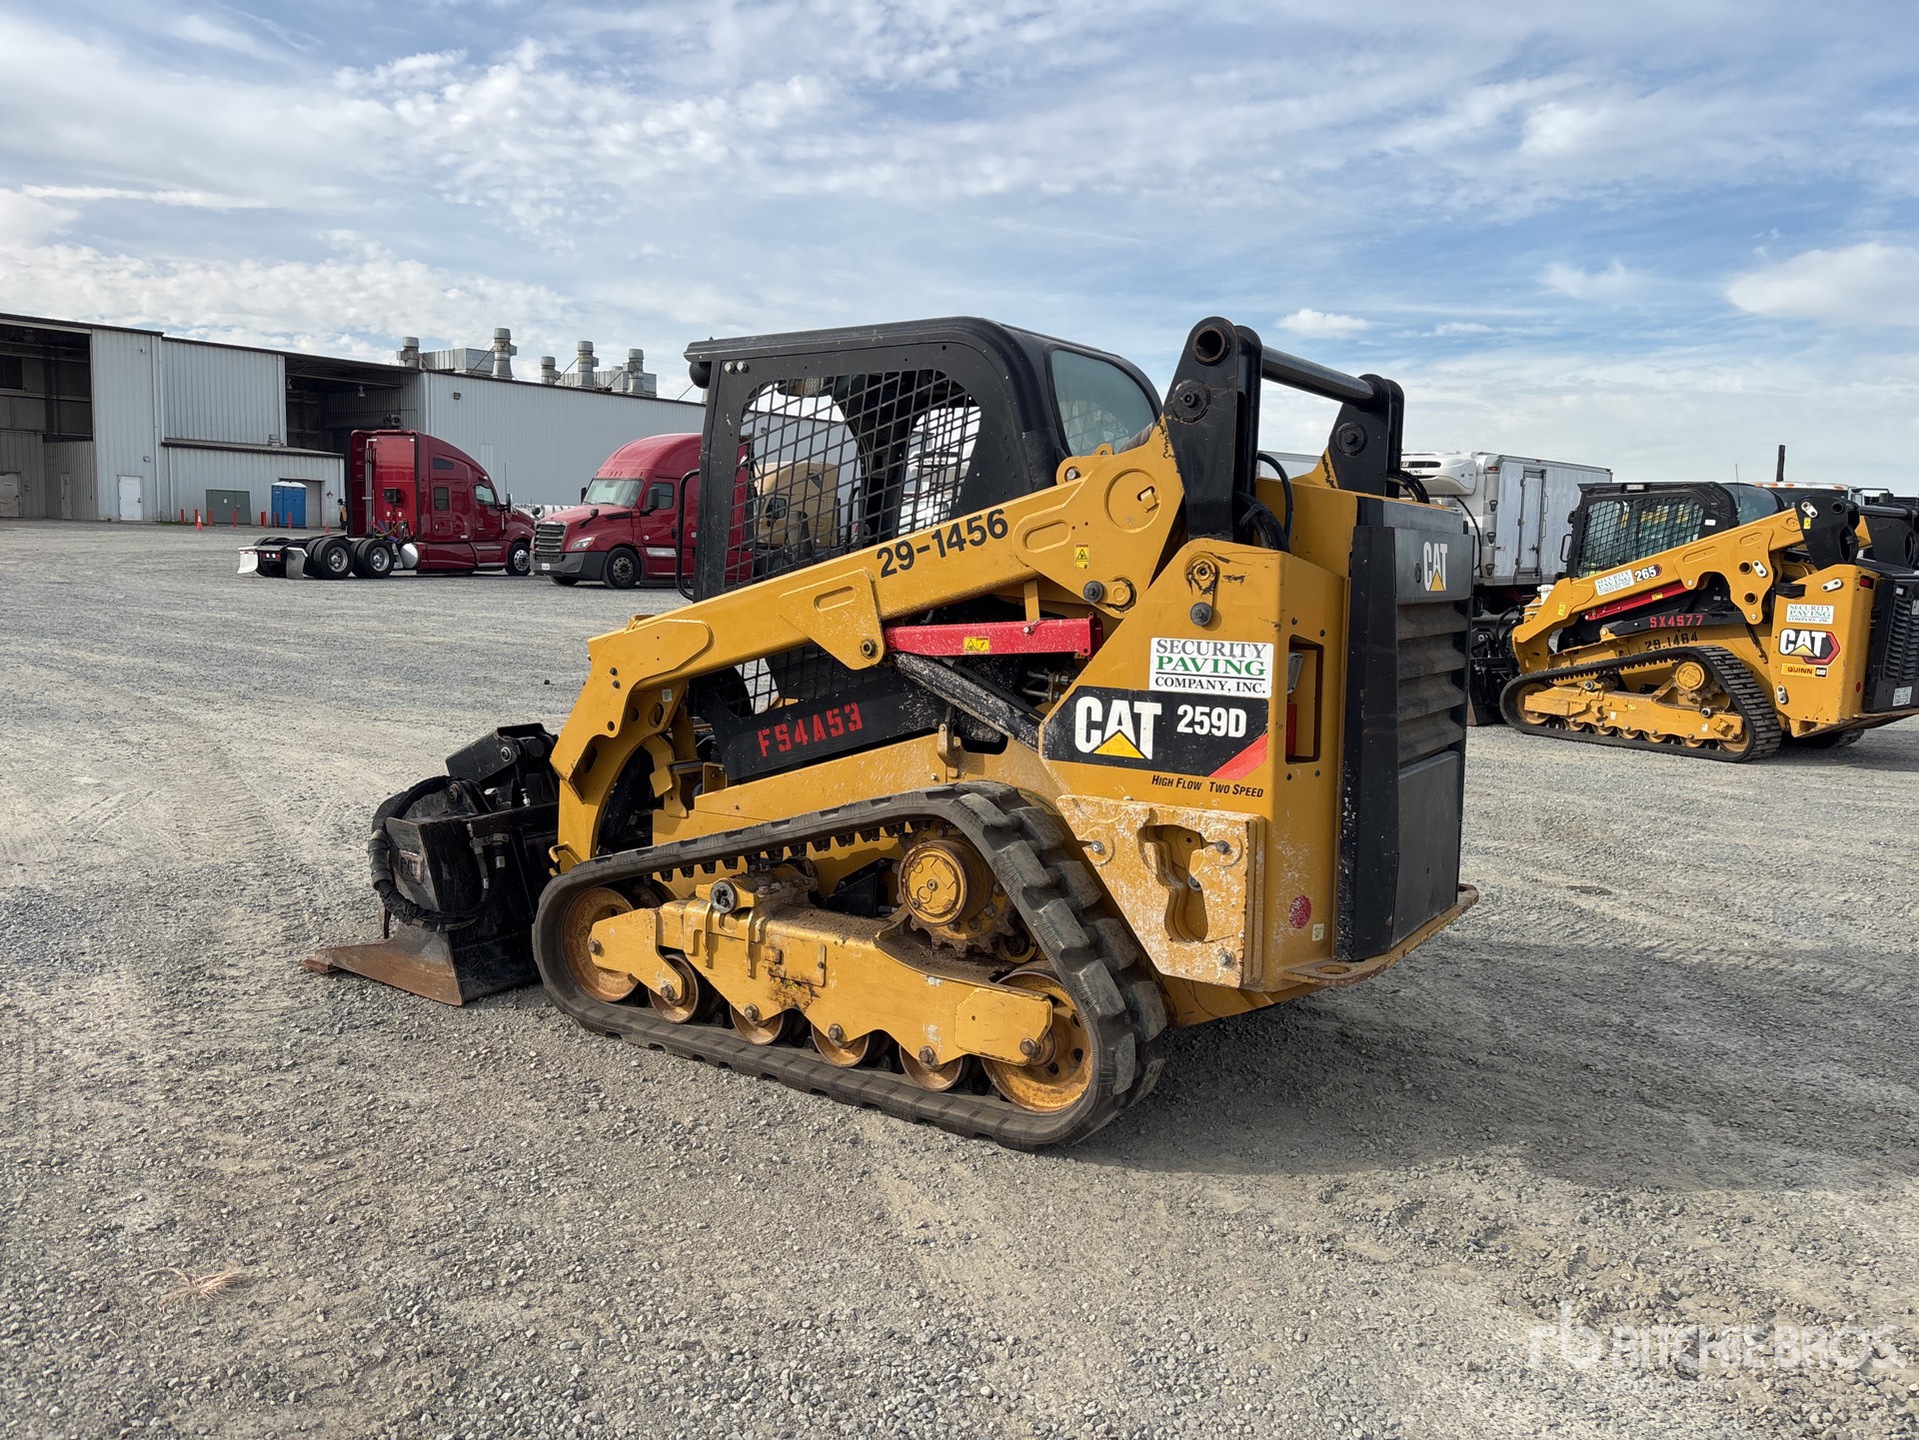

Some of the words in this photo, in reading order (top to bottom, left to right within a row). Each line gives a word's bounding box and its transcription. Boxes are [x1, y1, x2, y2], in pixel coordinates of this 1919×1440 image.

[876, 508, 1009, 579] 29-1456
[1423, 541, 1448, 592] CAT
[1634, 565, 1657, 583] 265
[1155, 639, 1267, 659] SECURITY
[1780, 628, 1827, 658] CAT
[1156, 655, 1267, 677] PAVING
[1787, 666, 1813, 674] QUINN
[1155, 676, 1232, 693] COMPANY,
[1236, 681, 1266, 694] INC.
[1074, 696, 1163, 760] CAT
[1176, 704, 1247, 739] 259D
[1151, 774, 1174, 788] HIGH
[1176, 777, 1202, 791] FLOW
[1209, 781, 1230, 795] TWO
[1232, 783, 1264, 798] SPEED
